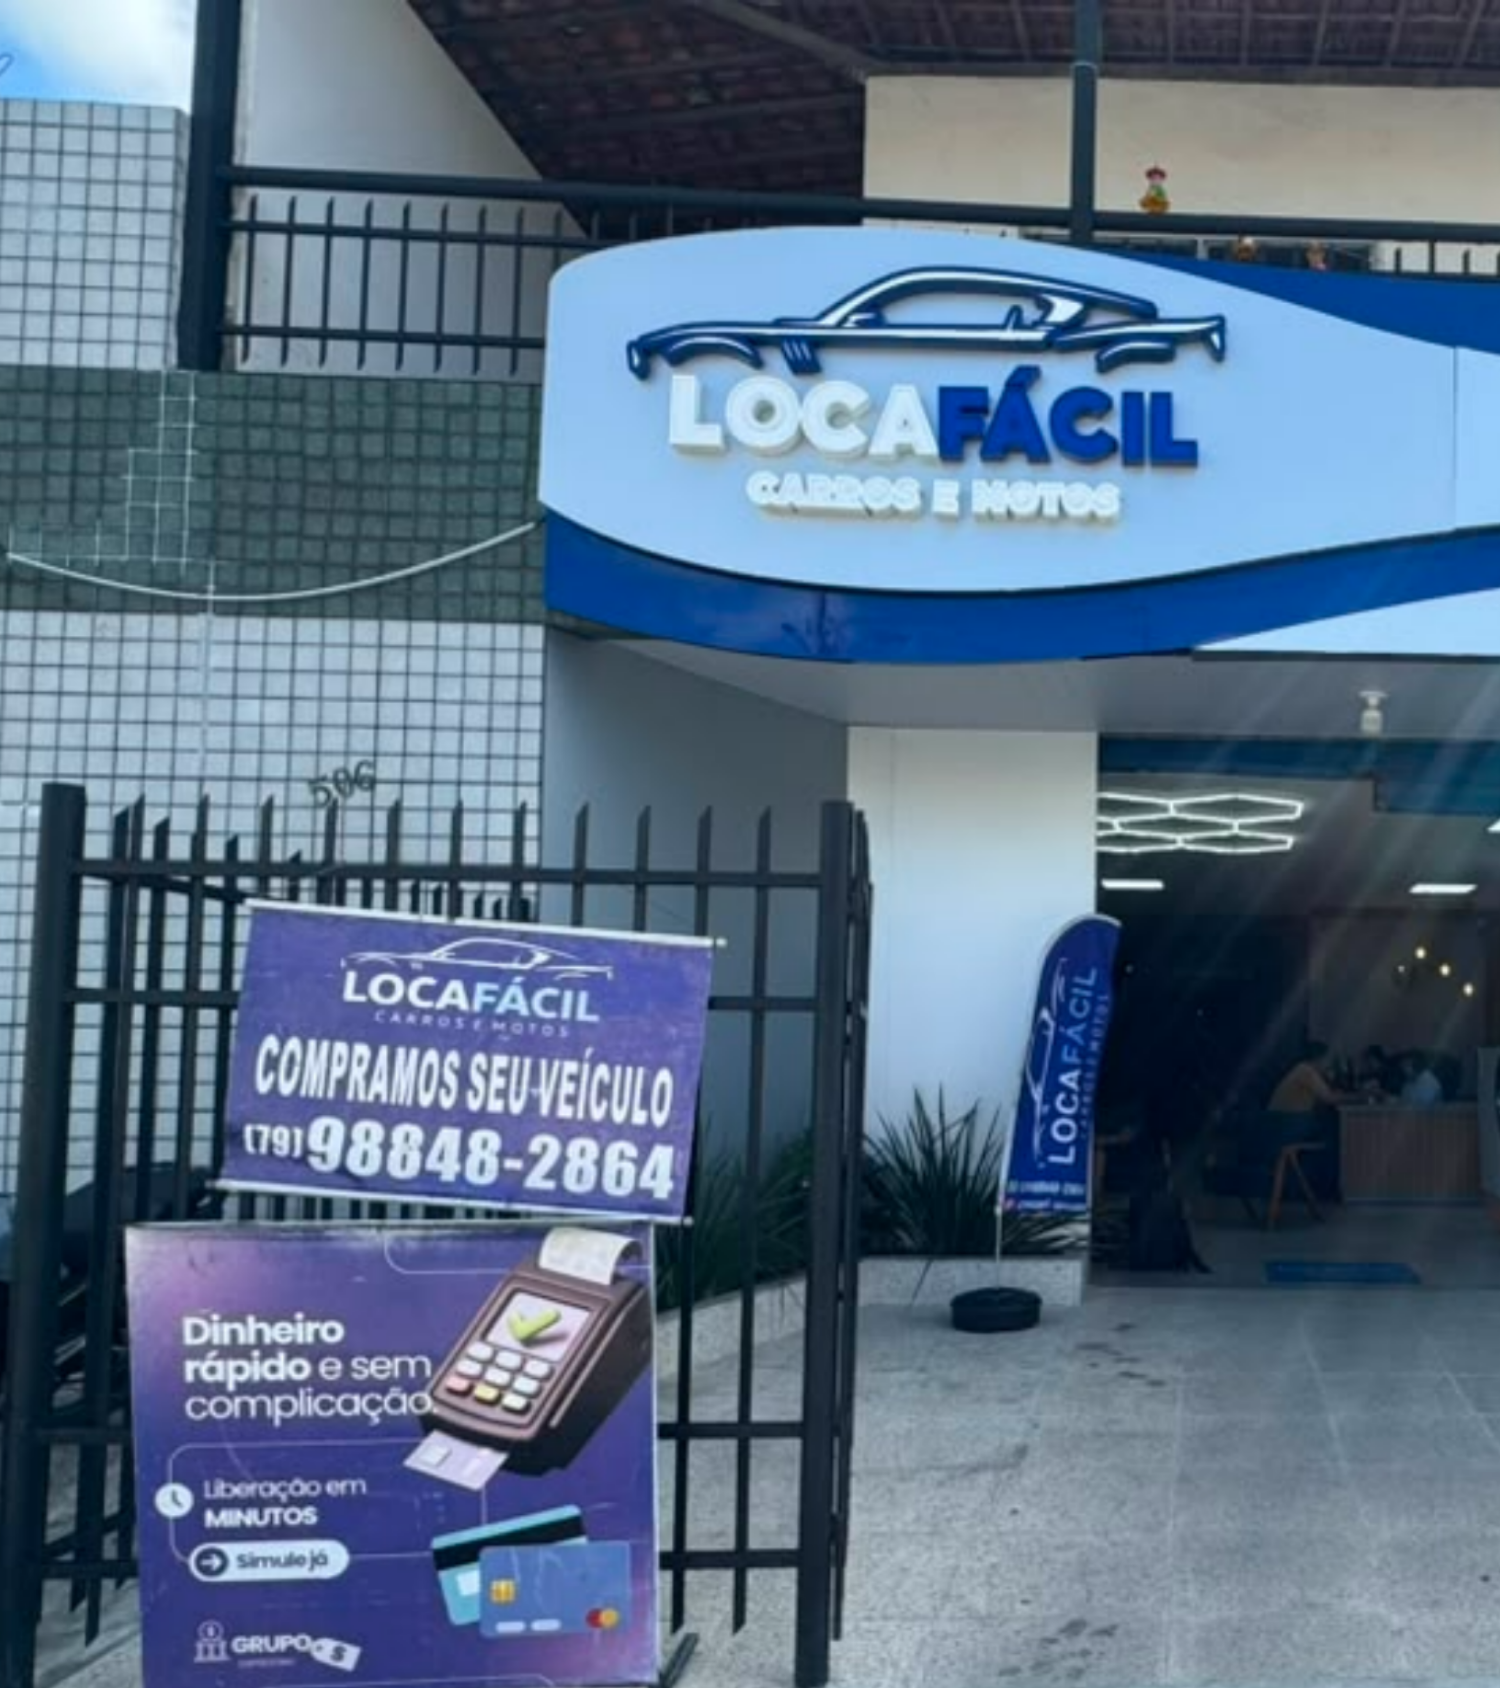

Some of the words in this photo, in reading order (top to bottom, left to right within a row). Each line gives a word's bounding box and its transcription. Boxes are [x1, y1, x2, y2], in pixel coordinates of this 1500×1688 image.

[667, 364, 1200, 468] LOCAFÁCIL
[745, 470, 921, 518] CARROS
[932, 480, 961, 517] E
[971, 479, 1121, 519] MOTOS
[343, 971, 600, 1022] LOCAFÁCIL
[374, 1009, 465, 1030] CARROS
[474, 1018, 482, 1031] E
[492, 1021, 569, 1038] MOTOS
[254, 1034, 459, 1110] COMPRAMOS
[467, 1054, 526, 1116] SEU
[537, 1047, 674, 1128] VEÍCULO
[1048, 967, 1097, 1165] LOCAFÁCIL
[182, 1312, 345, 1346] Dinheiro
[184, 1350, 311, 1392] rápido
[319, 1357, 342, 1380] e
[350, 1355, 432, 1380] sem
[203, 1477, 322, 1503] Liberação
[325, 1479, 368, 1496] em
[204, 1506, 319, 1528] MINUTOS
[236, 1552, 306, 1569] Simule
[307, 1550, 329, 1572] já
[231, 1633, 312, 1654] GRUPO
